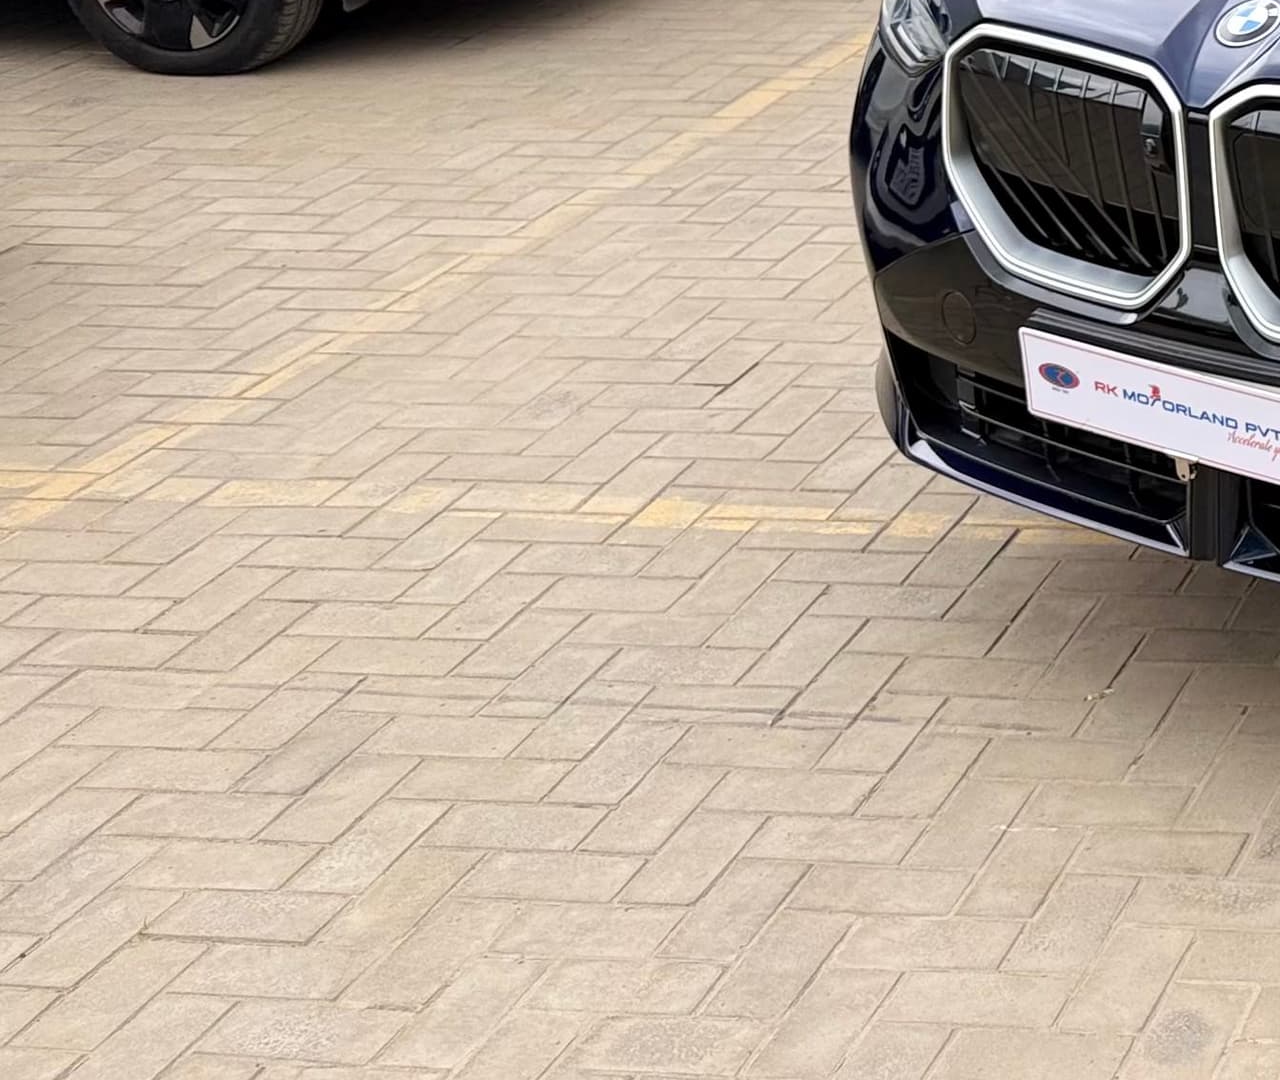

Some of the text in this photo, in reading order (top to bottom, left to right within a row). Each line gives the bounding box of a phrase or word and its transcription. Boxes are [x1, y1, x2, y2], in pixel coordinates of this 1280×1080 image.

[1094, 381, 1119, 397] RK
[1122, 384, 1239, 430] MOTORLAND
[1227, 430, 1273, 453] Accelerate
